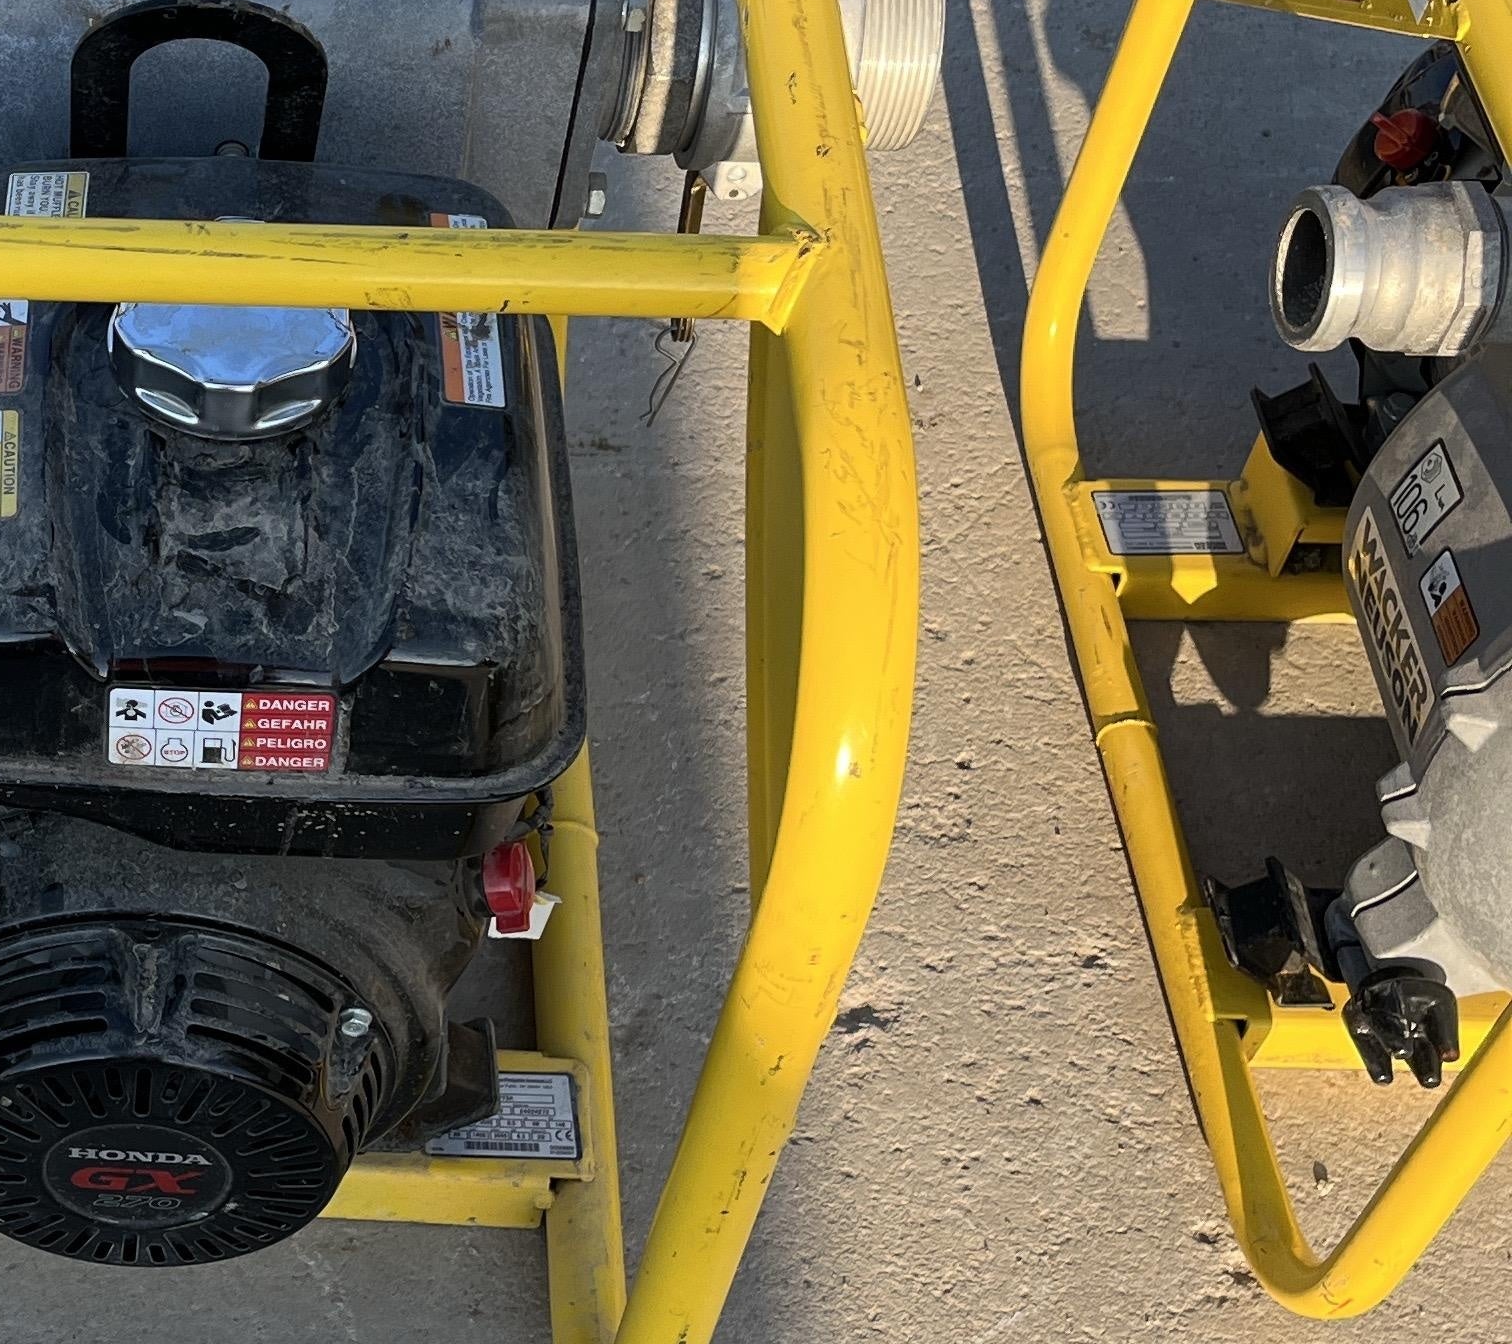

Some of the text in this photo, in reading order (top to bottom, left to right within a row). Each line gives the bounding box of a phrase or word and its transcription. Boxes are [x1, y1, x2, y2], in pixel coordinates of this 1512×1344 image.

[8, 337, 24, 390] WARNING
[3, 441, 17, 496] CAUTION
[1392, 473, 1428, 535] 106
[1363, 518, 1428, 713] WACKER
[1355, 548, 1418, 747] NEUSON
[258, 698, 331, 713] DANGER
[257, 717, 328, 731] GEFAHR
[256, 736, 328, 750] PELIGRO
[254, 754, 326, 769] DANGER
[68, 1147, 213, 1166] HONDA
[71, 1167, 205, 1195] GX
[93, 1193, 182, 1211] 270
